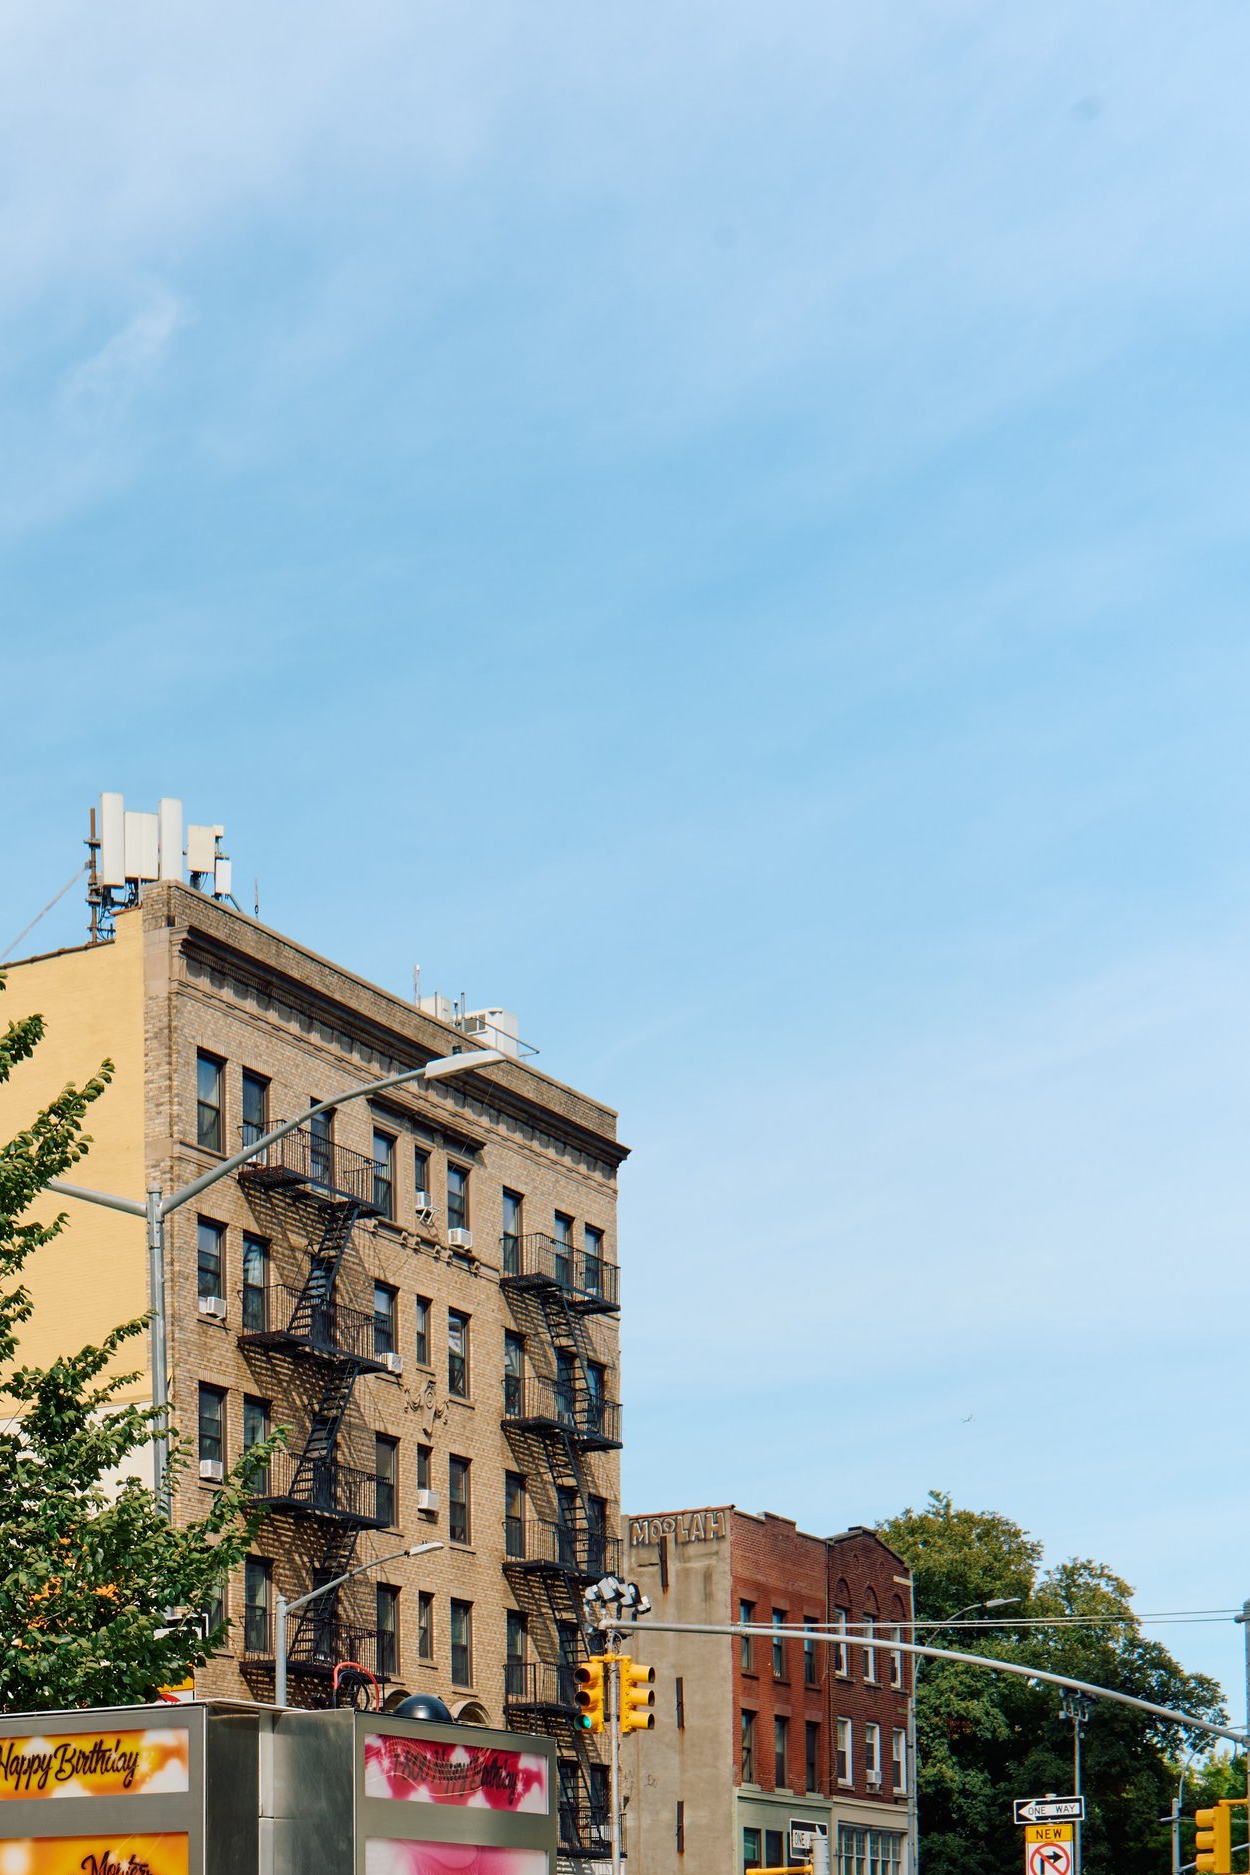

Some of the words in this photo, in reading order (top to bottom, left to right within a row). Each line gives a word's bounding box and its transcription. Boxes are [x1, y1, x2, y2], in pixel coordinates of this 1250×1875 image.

[630, 1511, 727, 1546] MOOLAH
[53, 1738, 140, 1789] Birthday
[1028, 1806, 1046, 1815] ONE
[1055, 1804, 1075, 1814] WAY
[1036, 1828, 1062, 1840] NEW
